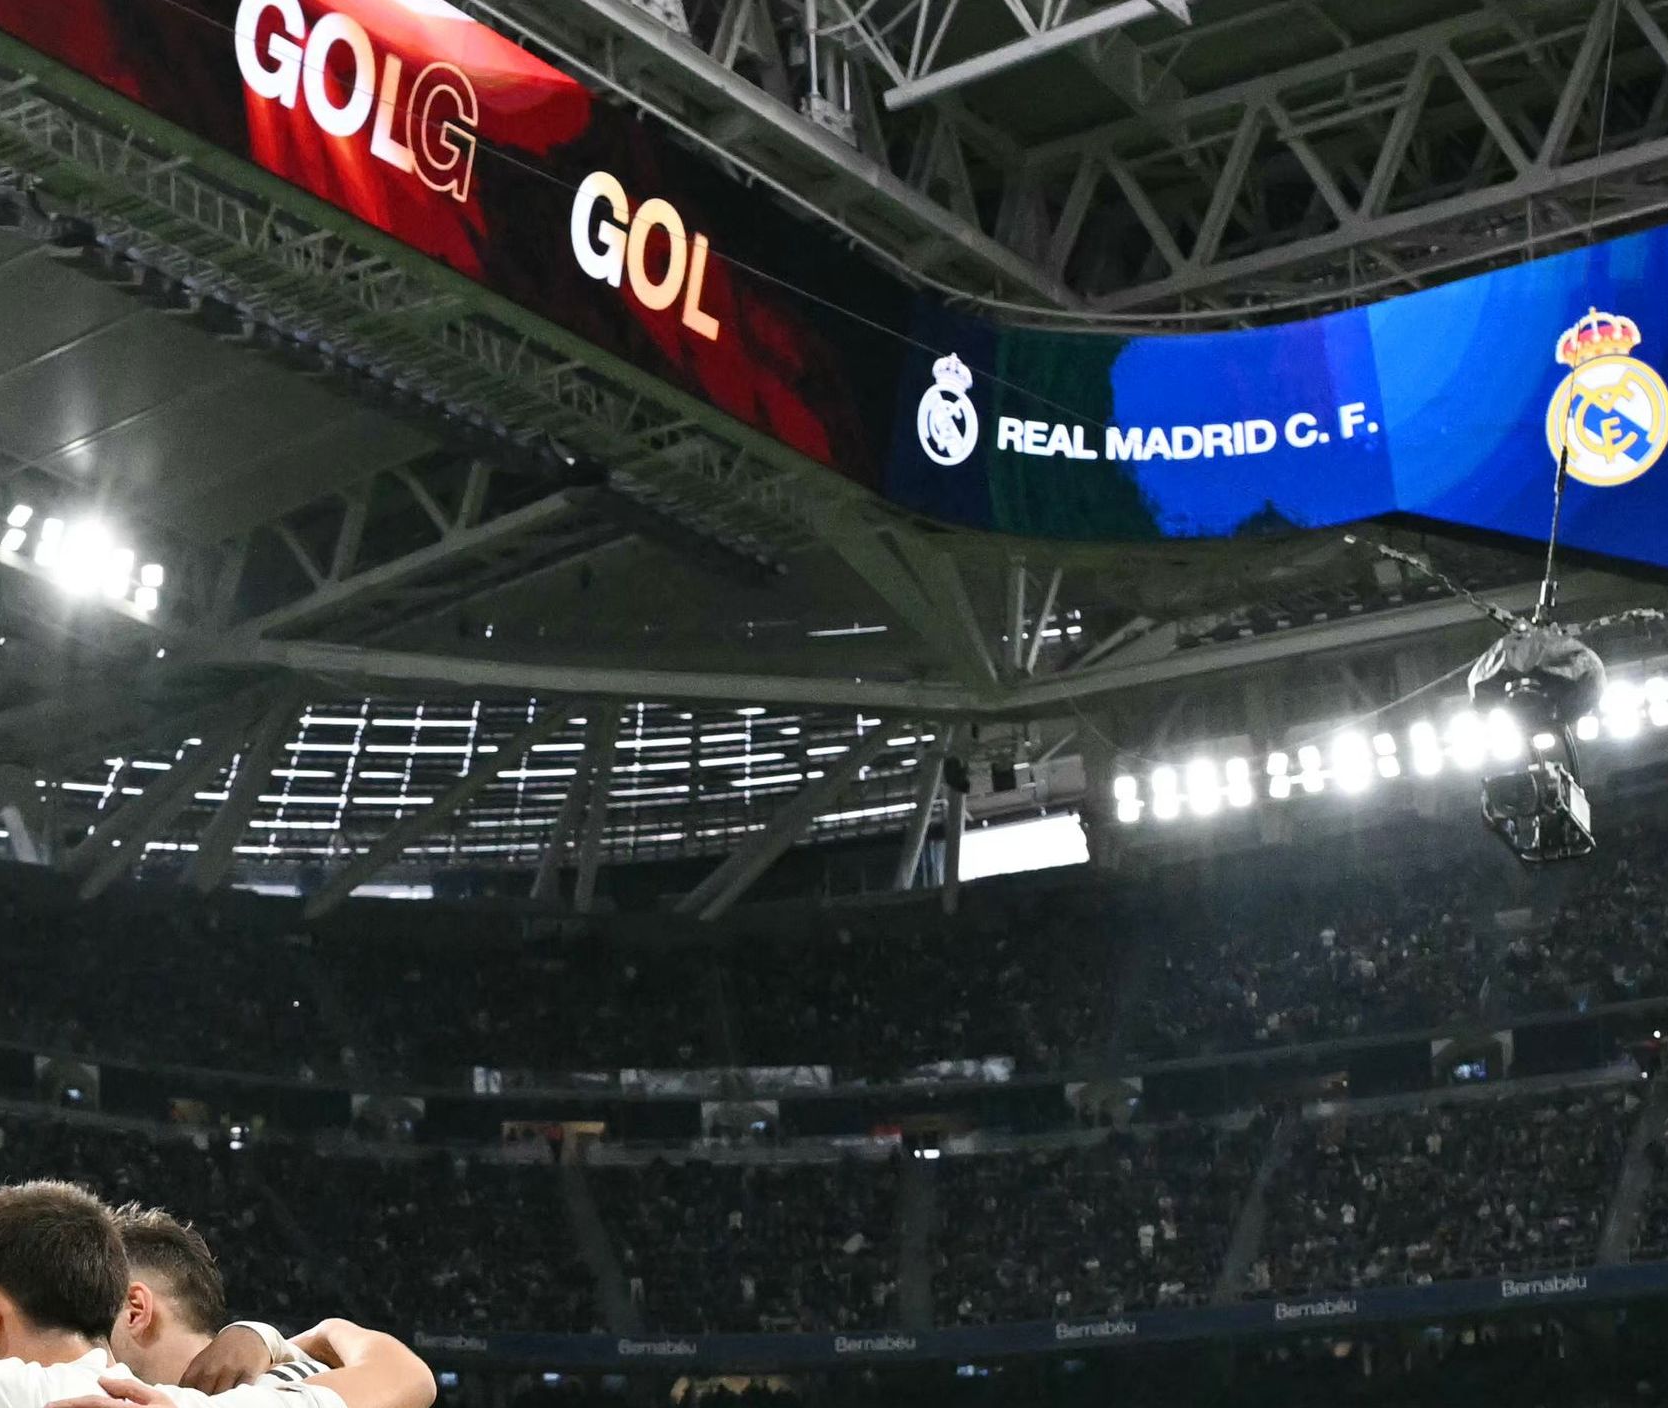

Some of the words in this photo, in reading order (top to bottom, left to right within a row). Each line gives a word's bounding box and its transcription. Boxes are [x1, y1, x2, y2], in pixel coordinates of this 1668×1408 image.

[570, 171, 719, 341] GOL
[997, 416, 1098, 461] REAL
[1105, 418, 1277, 462] MADRID
[1285, 412, 1331, 446] C.
[1339, 401, 1379, 440] F.
[1501, 1274, 1588, 1298] Bernabéu
